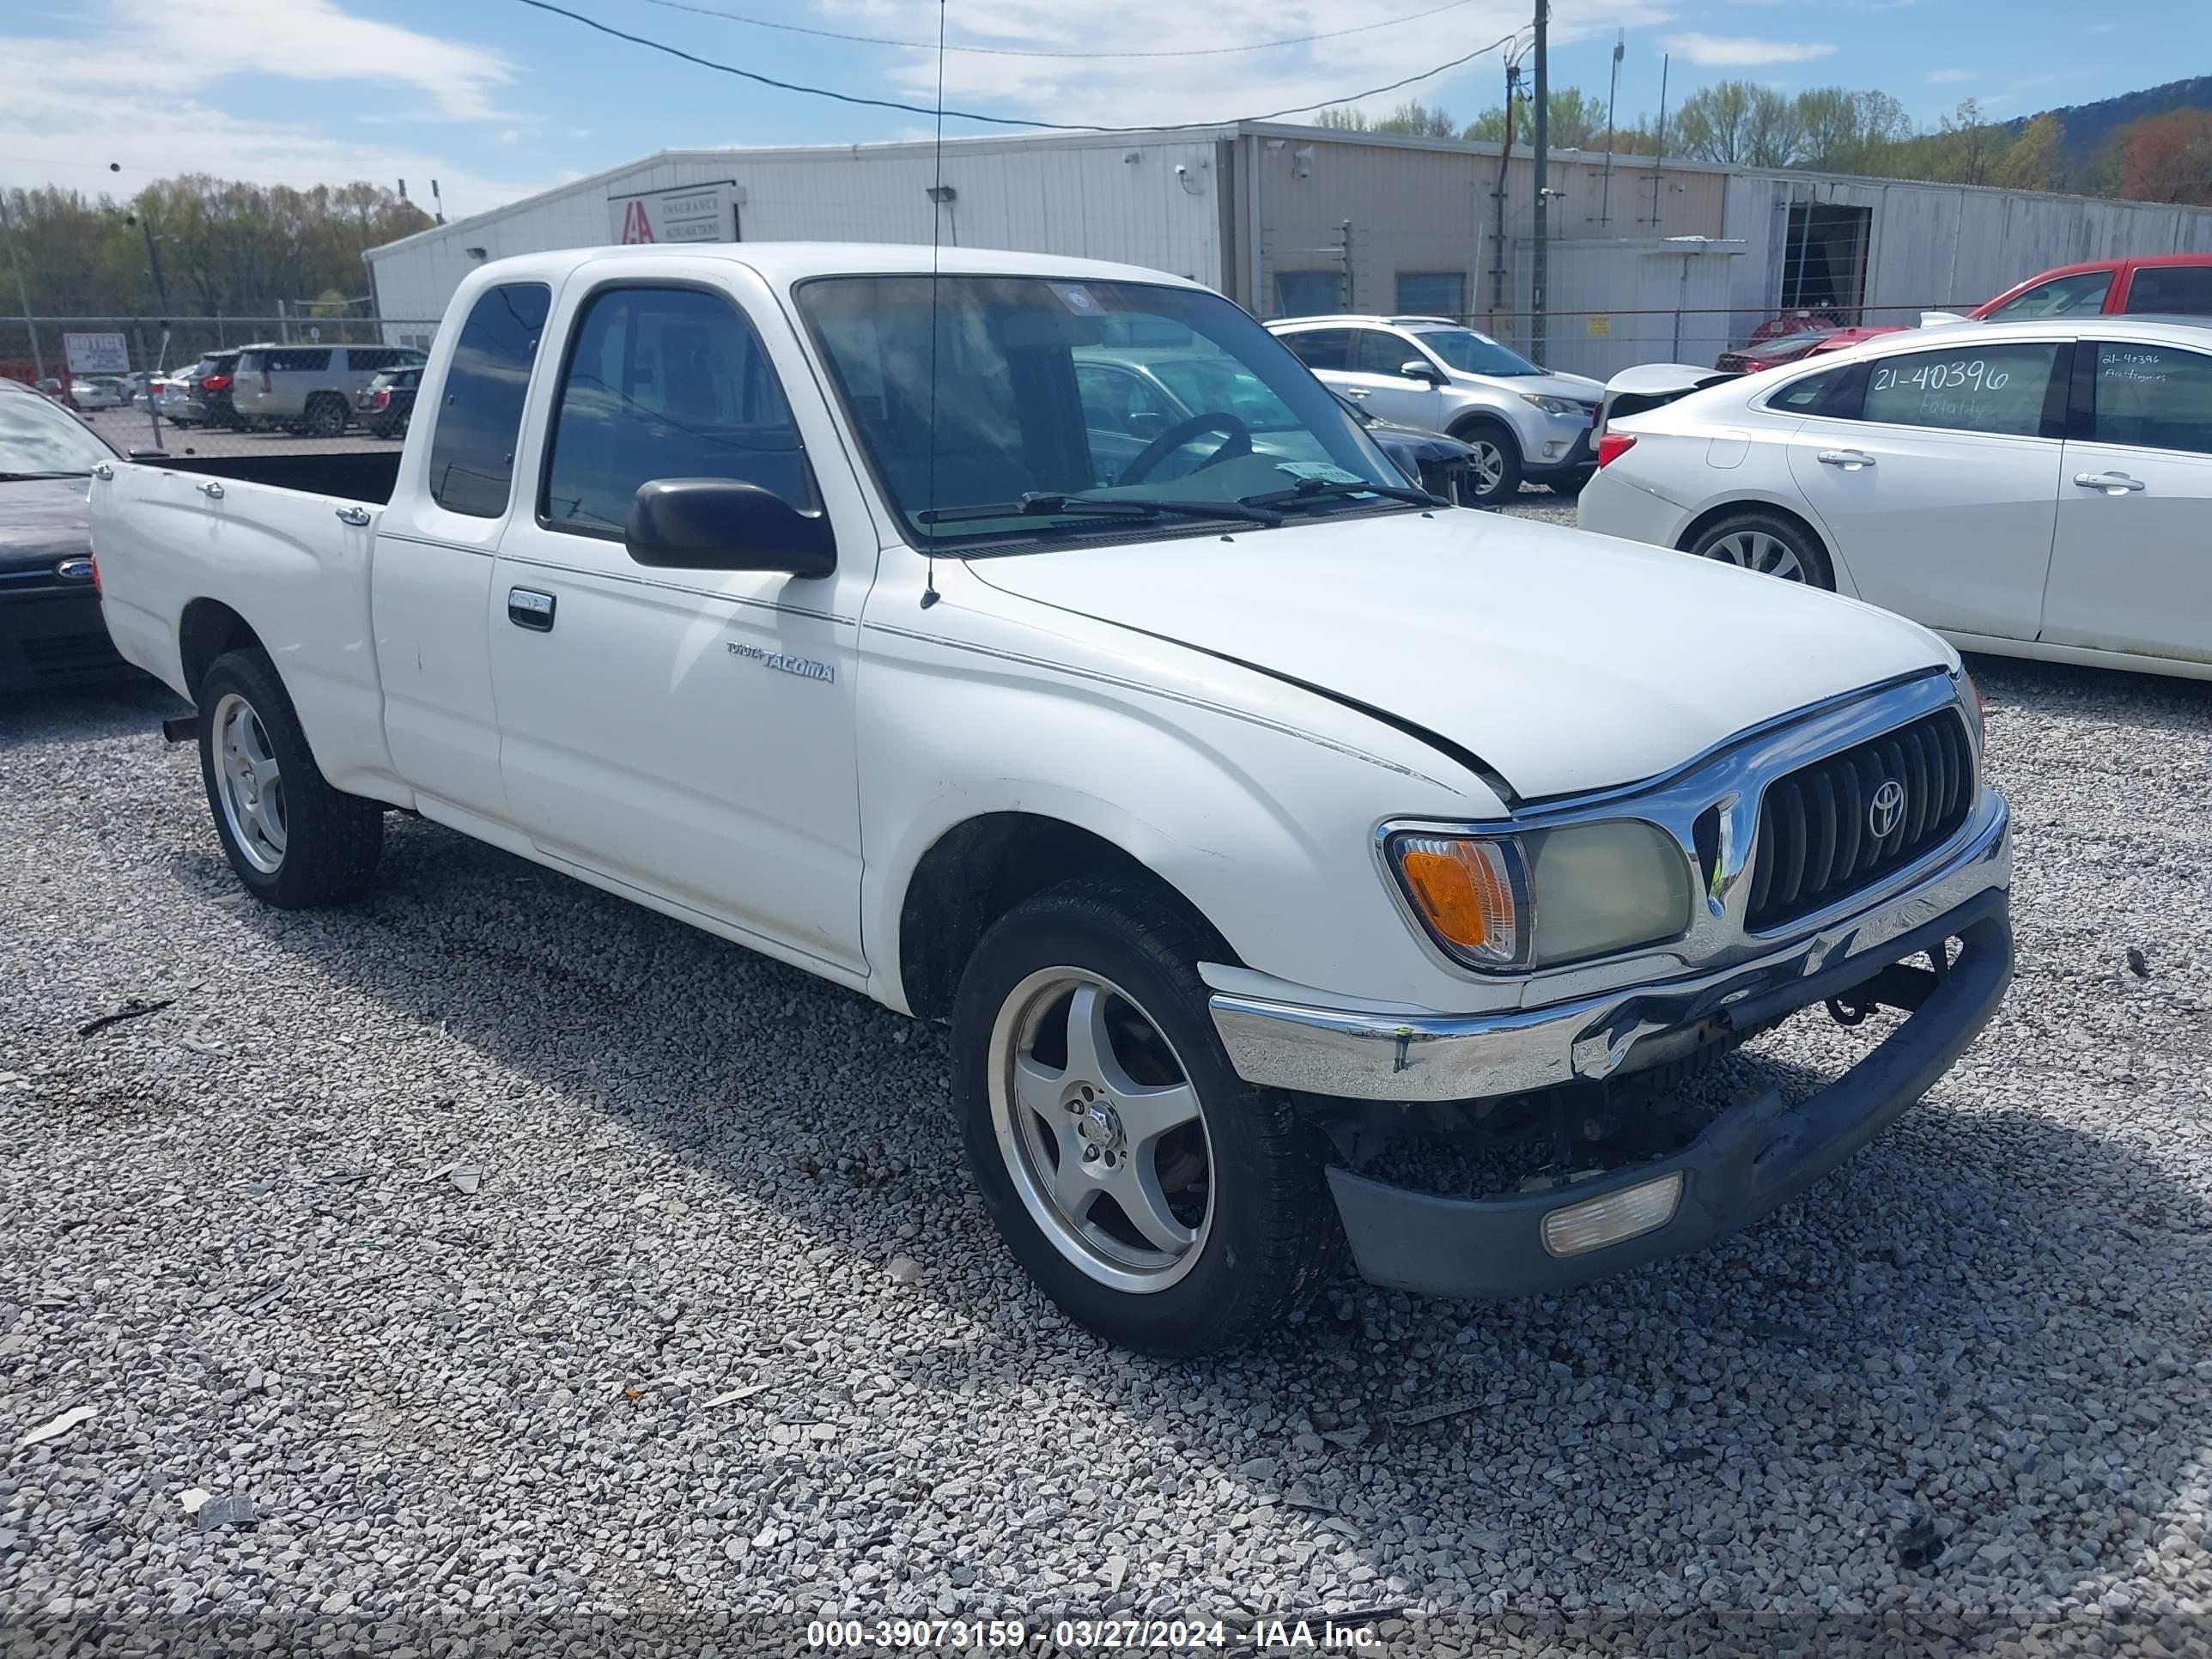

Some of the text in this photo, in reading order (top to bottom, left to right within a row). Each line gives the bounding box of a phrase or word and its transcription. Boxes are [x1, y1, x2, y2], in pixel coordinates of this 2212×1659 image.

[662, 198, 719, 215] INSURANCE
[69, 336, 124, 351] NOTICE
[2102, 353, 2160, 364] 21-40396
[1874, 360, 2009, 392] 21-40396
[763, 650, 835, 684] TACOMA
